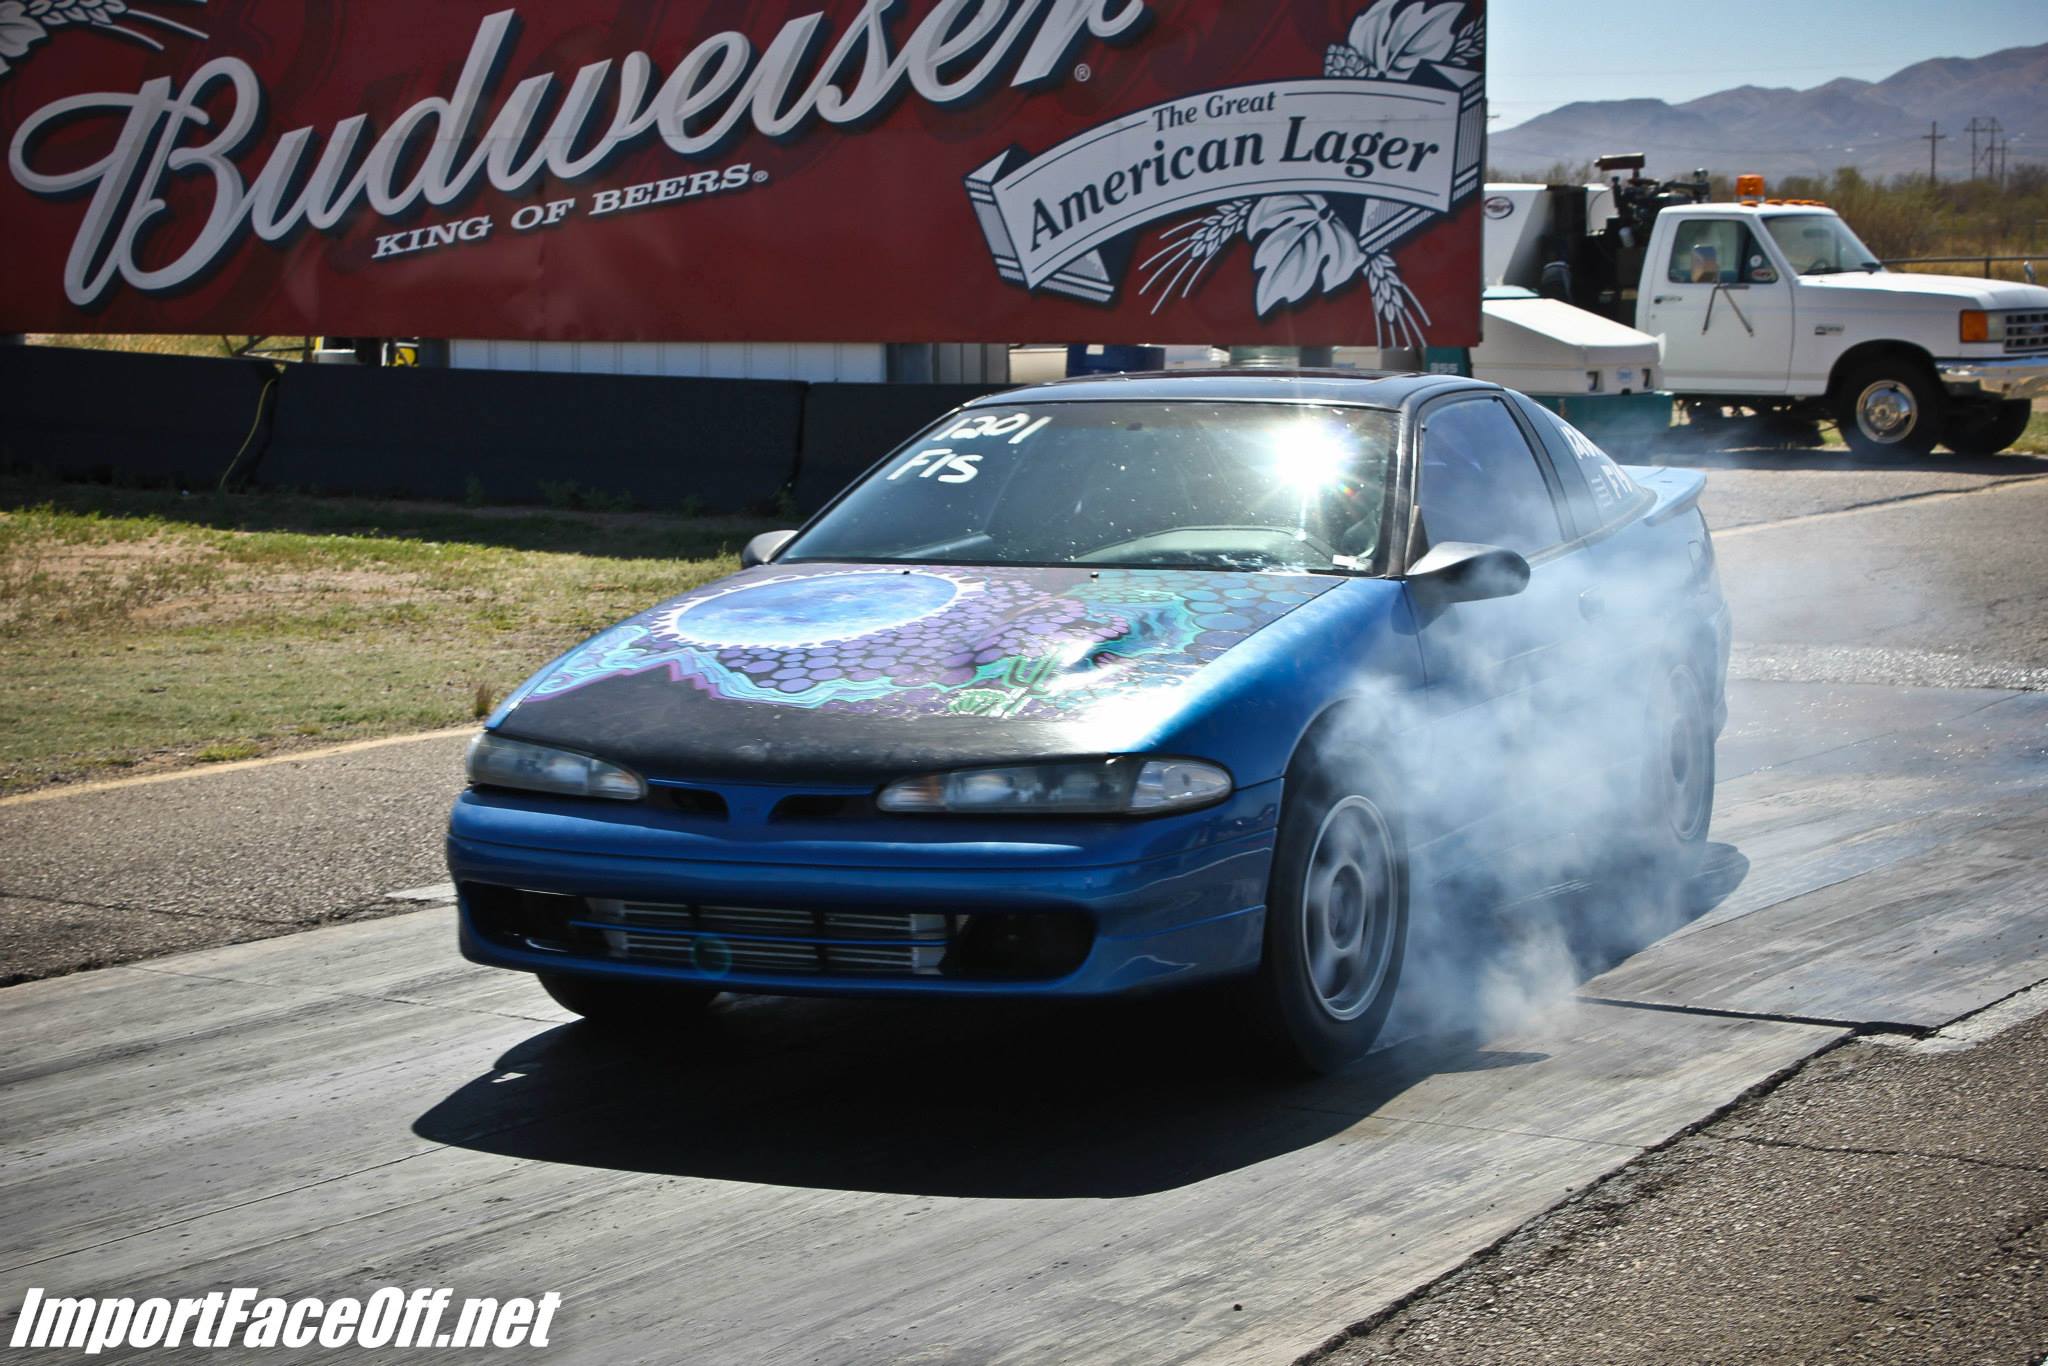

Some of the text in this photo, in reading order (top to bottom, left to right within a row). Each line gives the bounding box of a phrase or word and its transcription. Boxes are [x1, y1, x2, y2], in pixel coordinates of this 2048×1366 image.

[1152, 90, 1277, 132] The Great
[8, 0, 1145, 305] Budweiser
[1030, 115, 1440, 252] American Lager
[371, 214, 493, 258] KING
[510, 198, 576, 230] OF
[932, 412, 1052, 444] 1201
